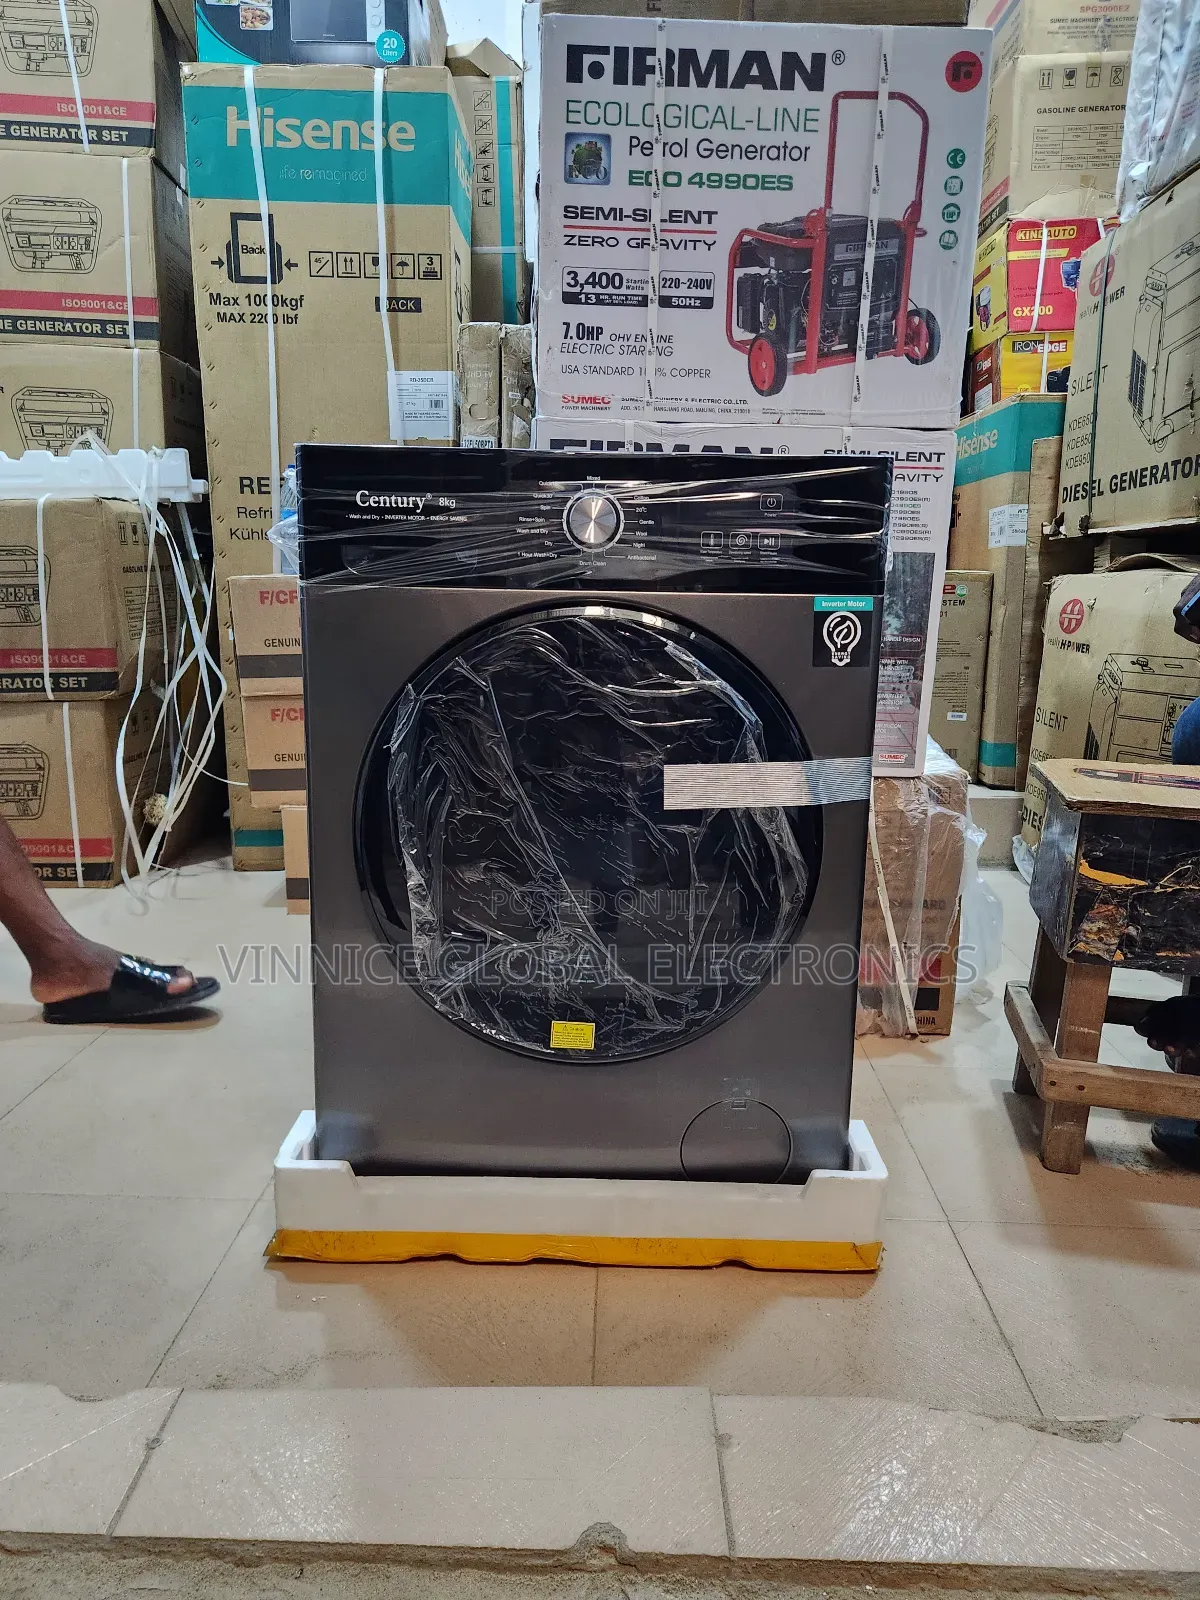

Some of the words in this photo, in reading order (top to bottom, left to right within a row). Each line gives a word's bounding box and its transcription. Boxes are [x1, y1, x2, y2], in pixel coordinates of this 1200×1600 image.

[383, 37, 398, 49] 20
[382, 49, 398, 57] Liters
[565, 43, 827, 92] FIRMAN
[57, 102, 127, 116] ISO001&CE
[1036, 106, 1076, 115] GASOLINE
[1078, 104, 1127, 113] GENERATOR
[226, 104, 416, 152] Hisense
[102, 130, 129, 142] SET
[628, 135, 688, 159] Perol
[696, 137, 811, 162] Generator
[299, 165, 367, 186] reimagined
[687, 172, 794, 191] 4990ES
[240, 244, 267, 255] Back
[563, 234, 620, 248] ZERO
[626, 237, 717, 251] GRAVITY
[426, 256, 434, 266] 3
[566, 270, 624, 293] 3,400
[625, 277, 650, 285] Startin
[208, 292, 239, 307] Max
[578, 294, 597, 304] 13
[671, 297, 702, 307] 50Hz
[216, 311, 246, 323] MAX
[282, 313, 299, 325] lbf
[16, 319, 102, 334] GENERATOR
[562, 321, 604, 341] 7.0HP
[609, 333, 632, 344] OHV
[634, 333, 674, 344] ENINE
[560, 342, 615, 355] ELECTRIC
[561, 364, 580, 375] USA
[582, 365, 635, 376] STANDARD
[670, 367, 711, 379] COPPER
[561, 394, 612, 405] SUMEC
[1062, 478, 1105, 504] DIESEL
[355, 490, 426, 513] Century
[438, 497, 456, 509] 8kg
[821, 600, 847, 608] Inverter
[847, 600, 866, 608] Motor
[59, 676, 88, 689] SET
[1035, 706, 1069, 733] SILENT
